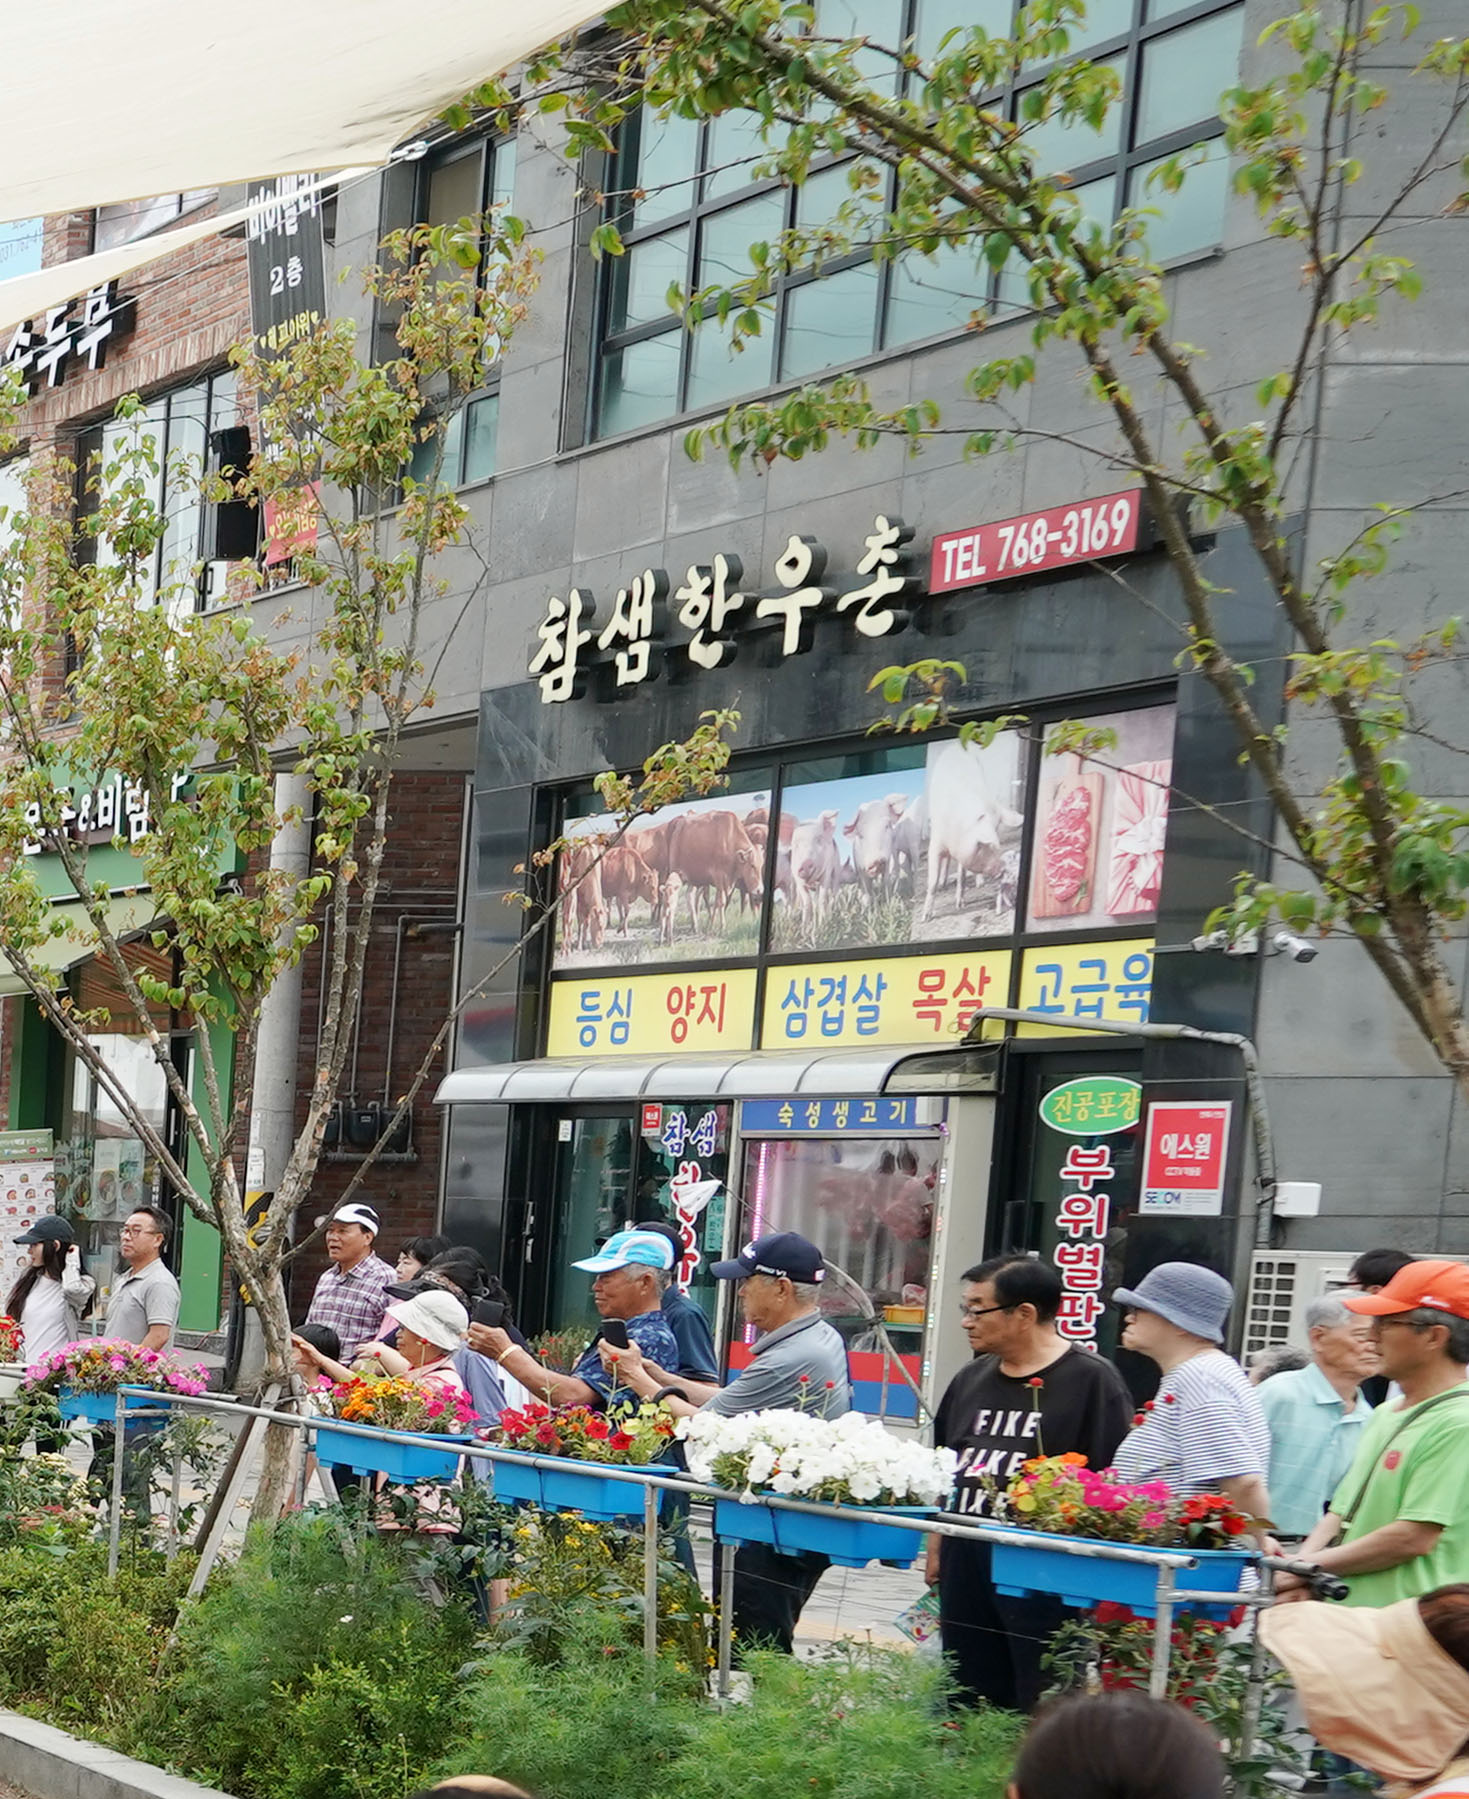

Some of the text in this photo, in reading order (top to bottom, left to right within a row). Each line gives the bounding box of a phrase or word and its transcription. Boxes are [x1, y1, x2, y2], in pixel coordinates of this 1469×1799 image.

[269, 255, 304, 296] 2층
[941, 498, 1130, 583] TEL 768-3169
[528, 513, 905, 703] 참샘한우촌
[576, 981, 726, 1047] 등심 양지
[780, 965, 992, 1039] 삼겹살 목살
[662, 1110, 718, 1157] 참샘
[1051, 1087, 1141, 1123] 진공포장
[1159, 1133, 1212, 1160] 에스원
[1054, 1144, 1115, 1352] 부위별판
